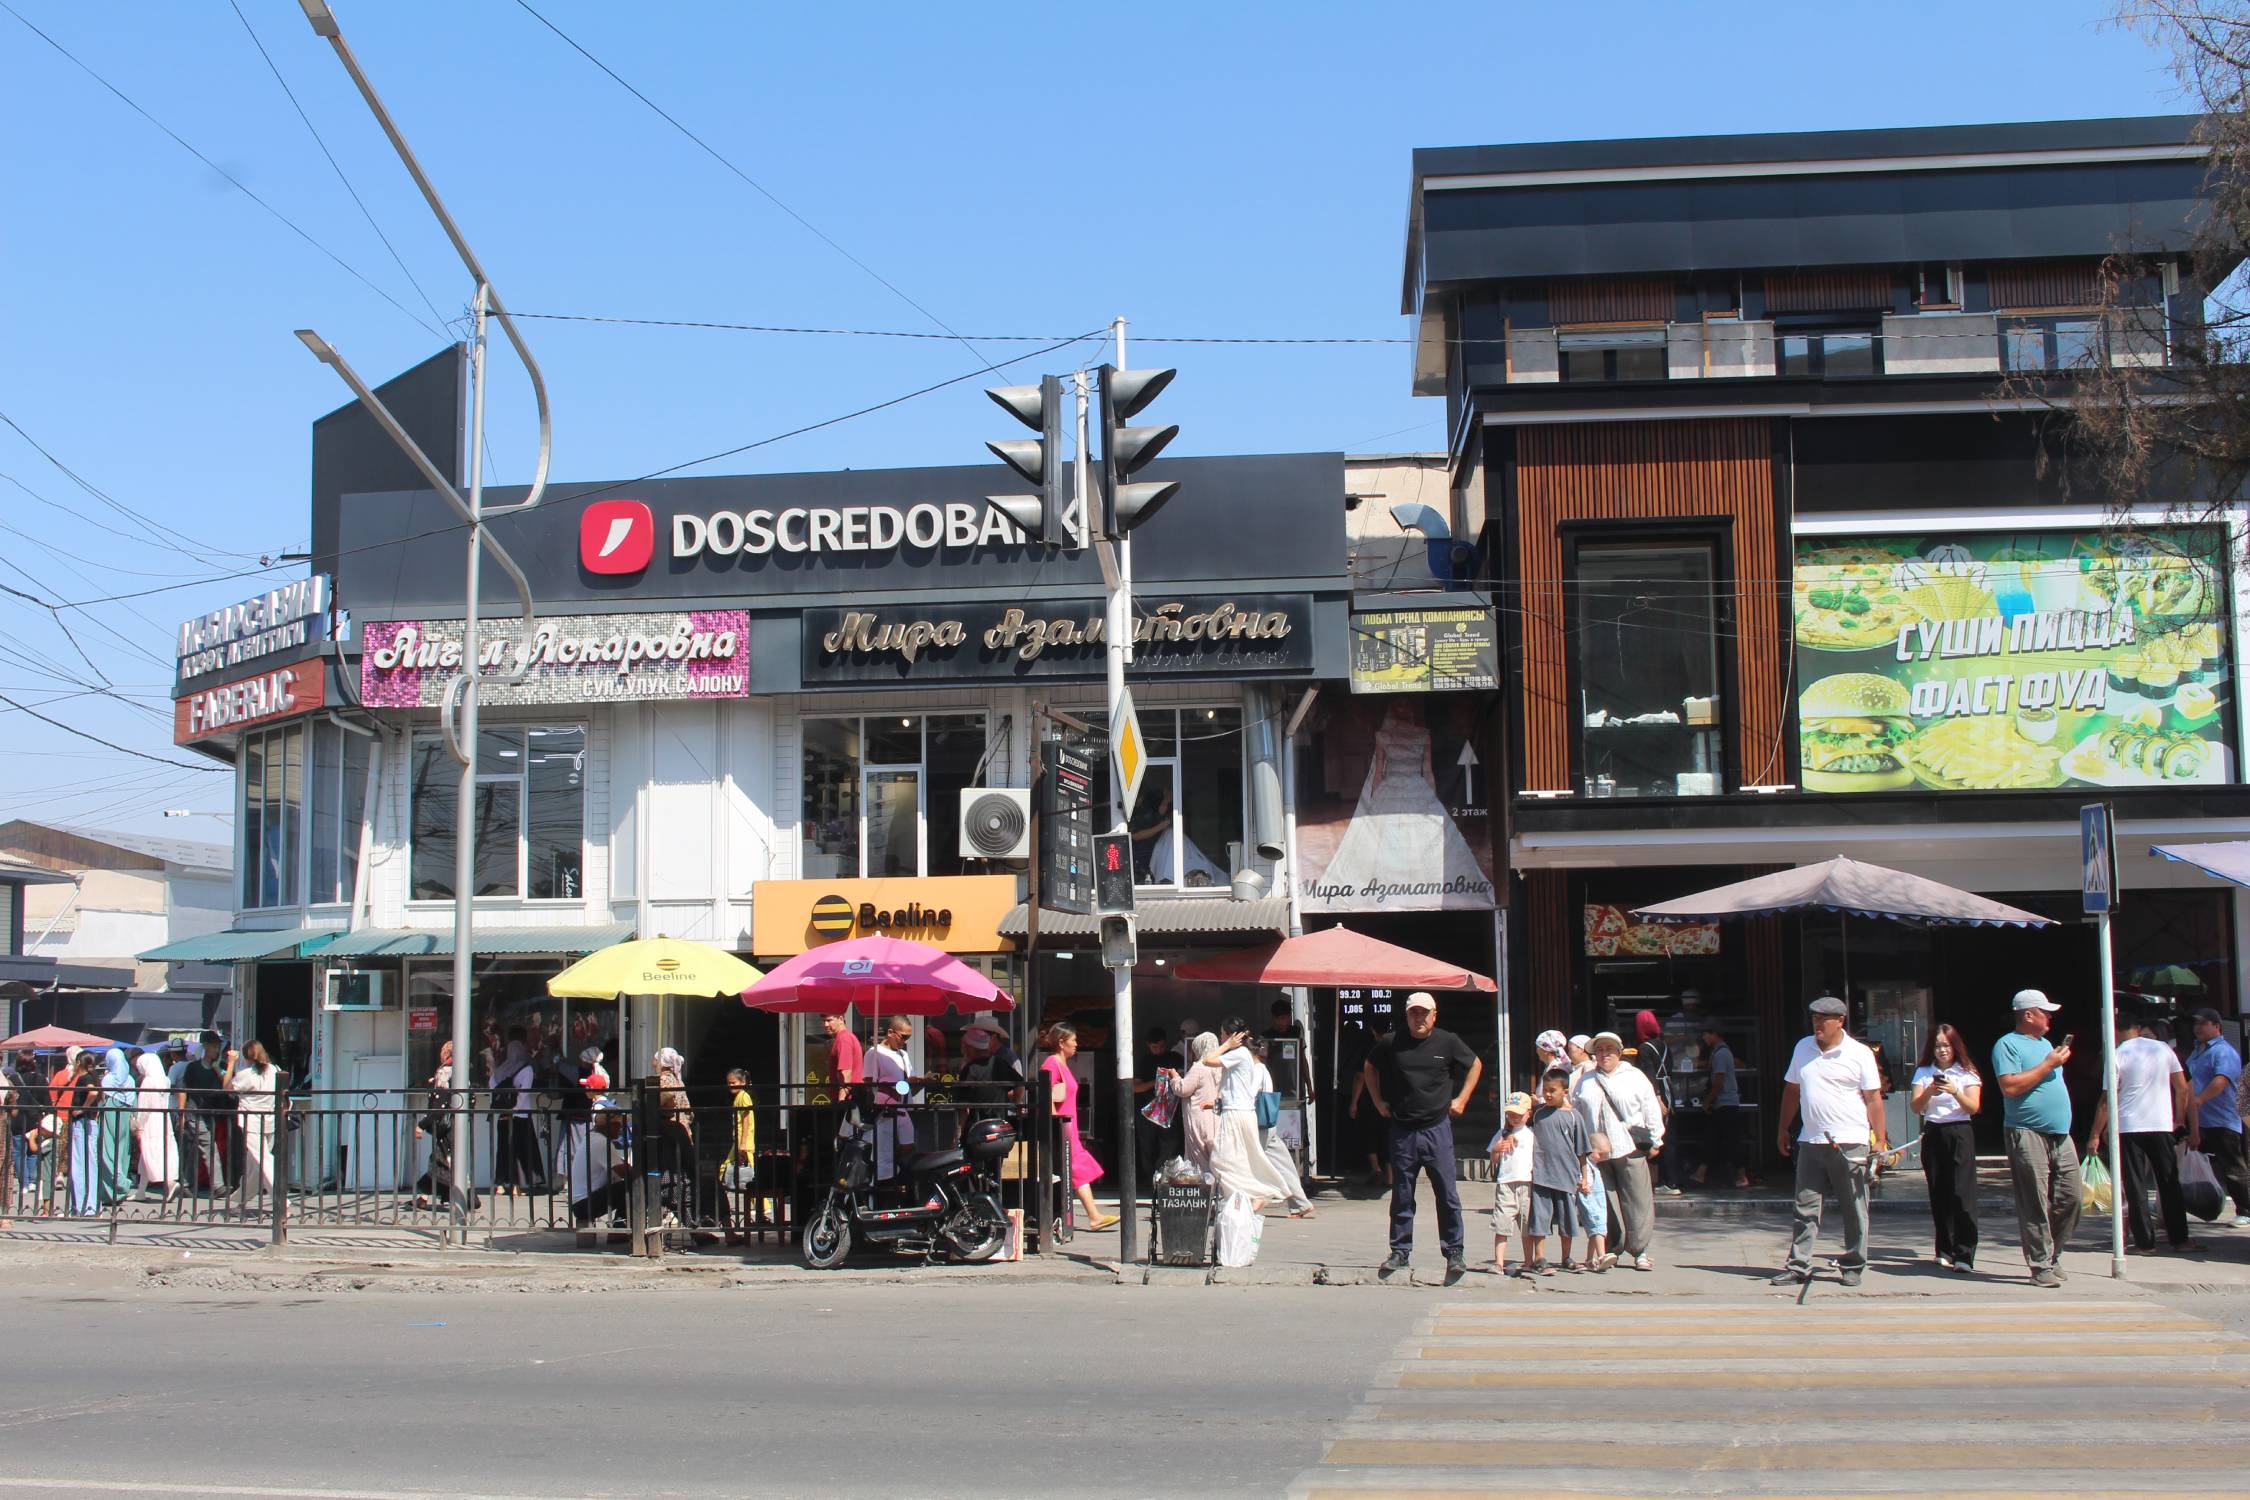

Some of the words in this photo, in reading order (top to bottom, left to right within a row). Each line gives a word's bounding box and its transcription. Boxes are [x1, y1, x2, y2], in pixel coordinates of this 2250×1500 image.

[1361, 613, 1393, 625] ГЛОБАЛ
[1395, 612, 1420, 624] ТРЕНД
[1422, 610, 1485, 623] КОМПАНИЯСЫ
[823, 611, 967, 663] Мира
[1896, 616, 2004, 662] СУШИ
[2008, 606, 2136, 653] ПИЦЦА
[515, 620, 737, 674] Аскаровна
[676, 675, 742, 694] САЛОНУ
[1375, 682, 1399, 690] Global
[1910, 675, 2014, 718] ФАСТ
[2018, 667, 2109, 711] ФУД
[190, 670, 295, 733] FABERLIC
[1452, 808, 1458, 816] 2
[1462, 808, 1488, 816] этаж
[1360, 875, 1491, 904] Азаматовна
[859, 902, 953, 929] Beeline
[642, 971, 697, 981] Beeline
[1340, 990, 1361, 999] 99.20
[1162, 1198, 1207, 1208] ТАЗАЛЫК
